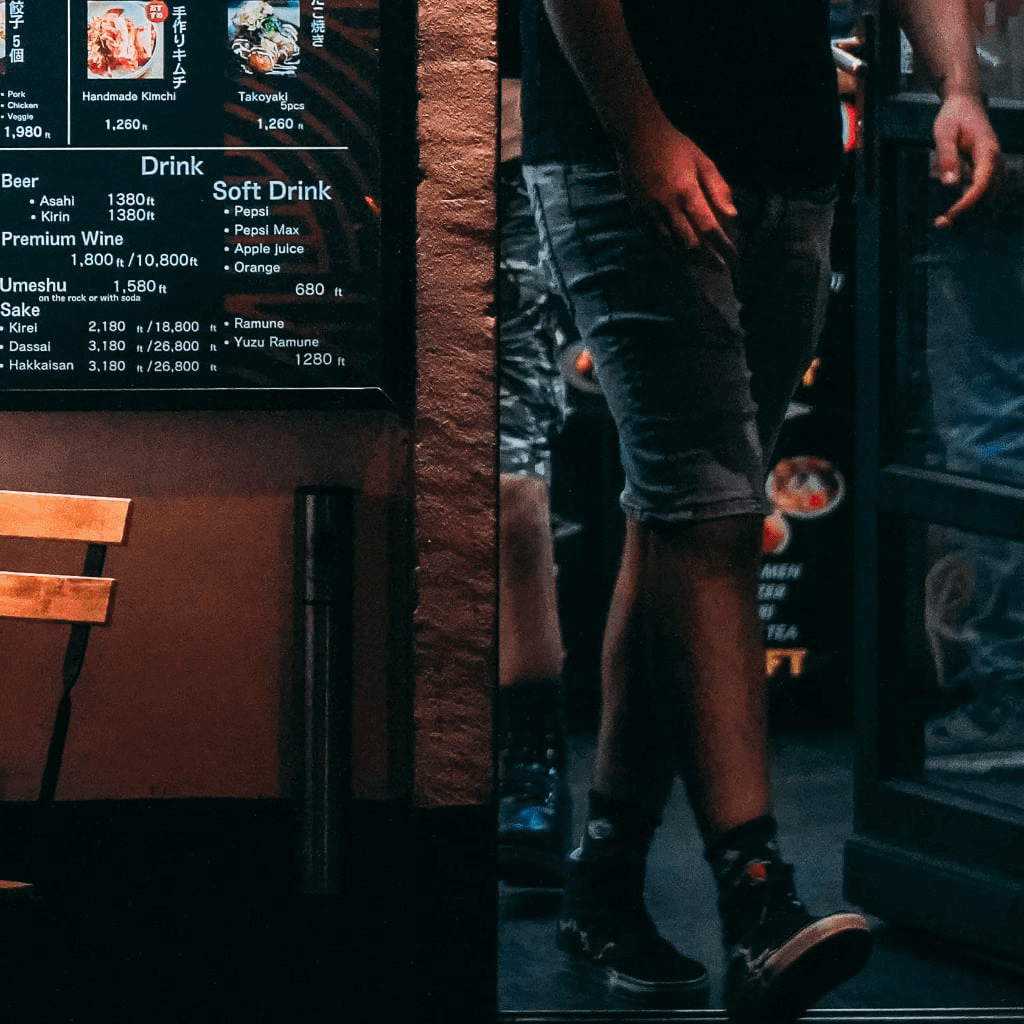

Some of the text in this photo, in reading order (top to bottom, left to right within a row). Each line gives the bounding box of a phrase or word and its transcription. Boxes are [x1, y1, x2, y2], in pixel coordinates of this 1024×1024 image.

[83, 92, 176, 101] Handmade Kimchi
[238, 91, 288, 102] Takoyaki
[279, 101, 305, 112] 5pcs
[106, 119, 140, 130] 1,260
[258, 118, 293, 130] 1,260
[5, 126, 42, 139] 1,980
[142, 156, 203, 175] Drink
[2, 173, 39, 188] Beer
[213, 180, 331, 200] Soft Drink
[40, 195, 74, 206] Asahi
[42, 211, 69, 221] Kirin
[235, 205, 268, 218] Pepsi
[235, 224, 299, 237] Pepsi Max
[2, 231, 123, 246] Premium Wine
[234, 243, 304, 256] Apple juice
[235, 261, 280, 274] Orange
[0, 277, 66, 292] Umeshu
[296, 283, 324, 295] 680
[1, 302, 40, 316] Sake
[10, 321, 125, 333] Kirei 2,180
[235, 318, 284, 328] Ramune
[10, 340, 125, 352] Dassai 3,180
[234, 336, 319, 347] Yuzu Ramune
[296, 353, 332, 365] 1280
[10, 360, 125, 372] Hakkaisan 3,180
